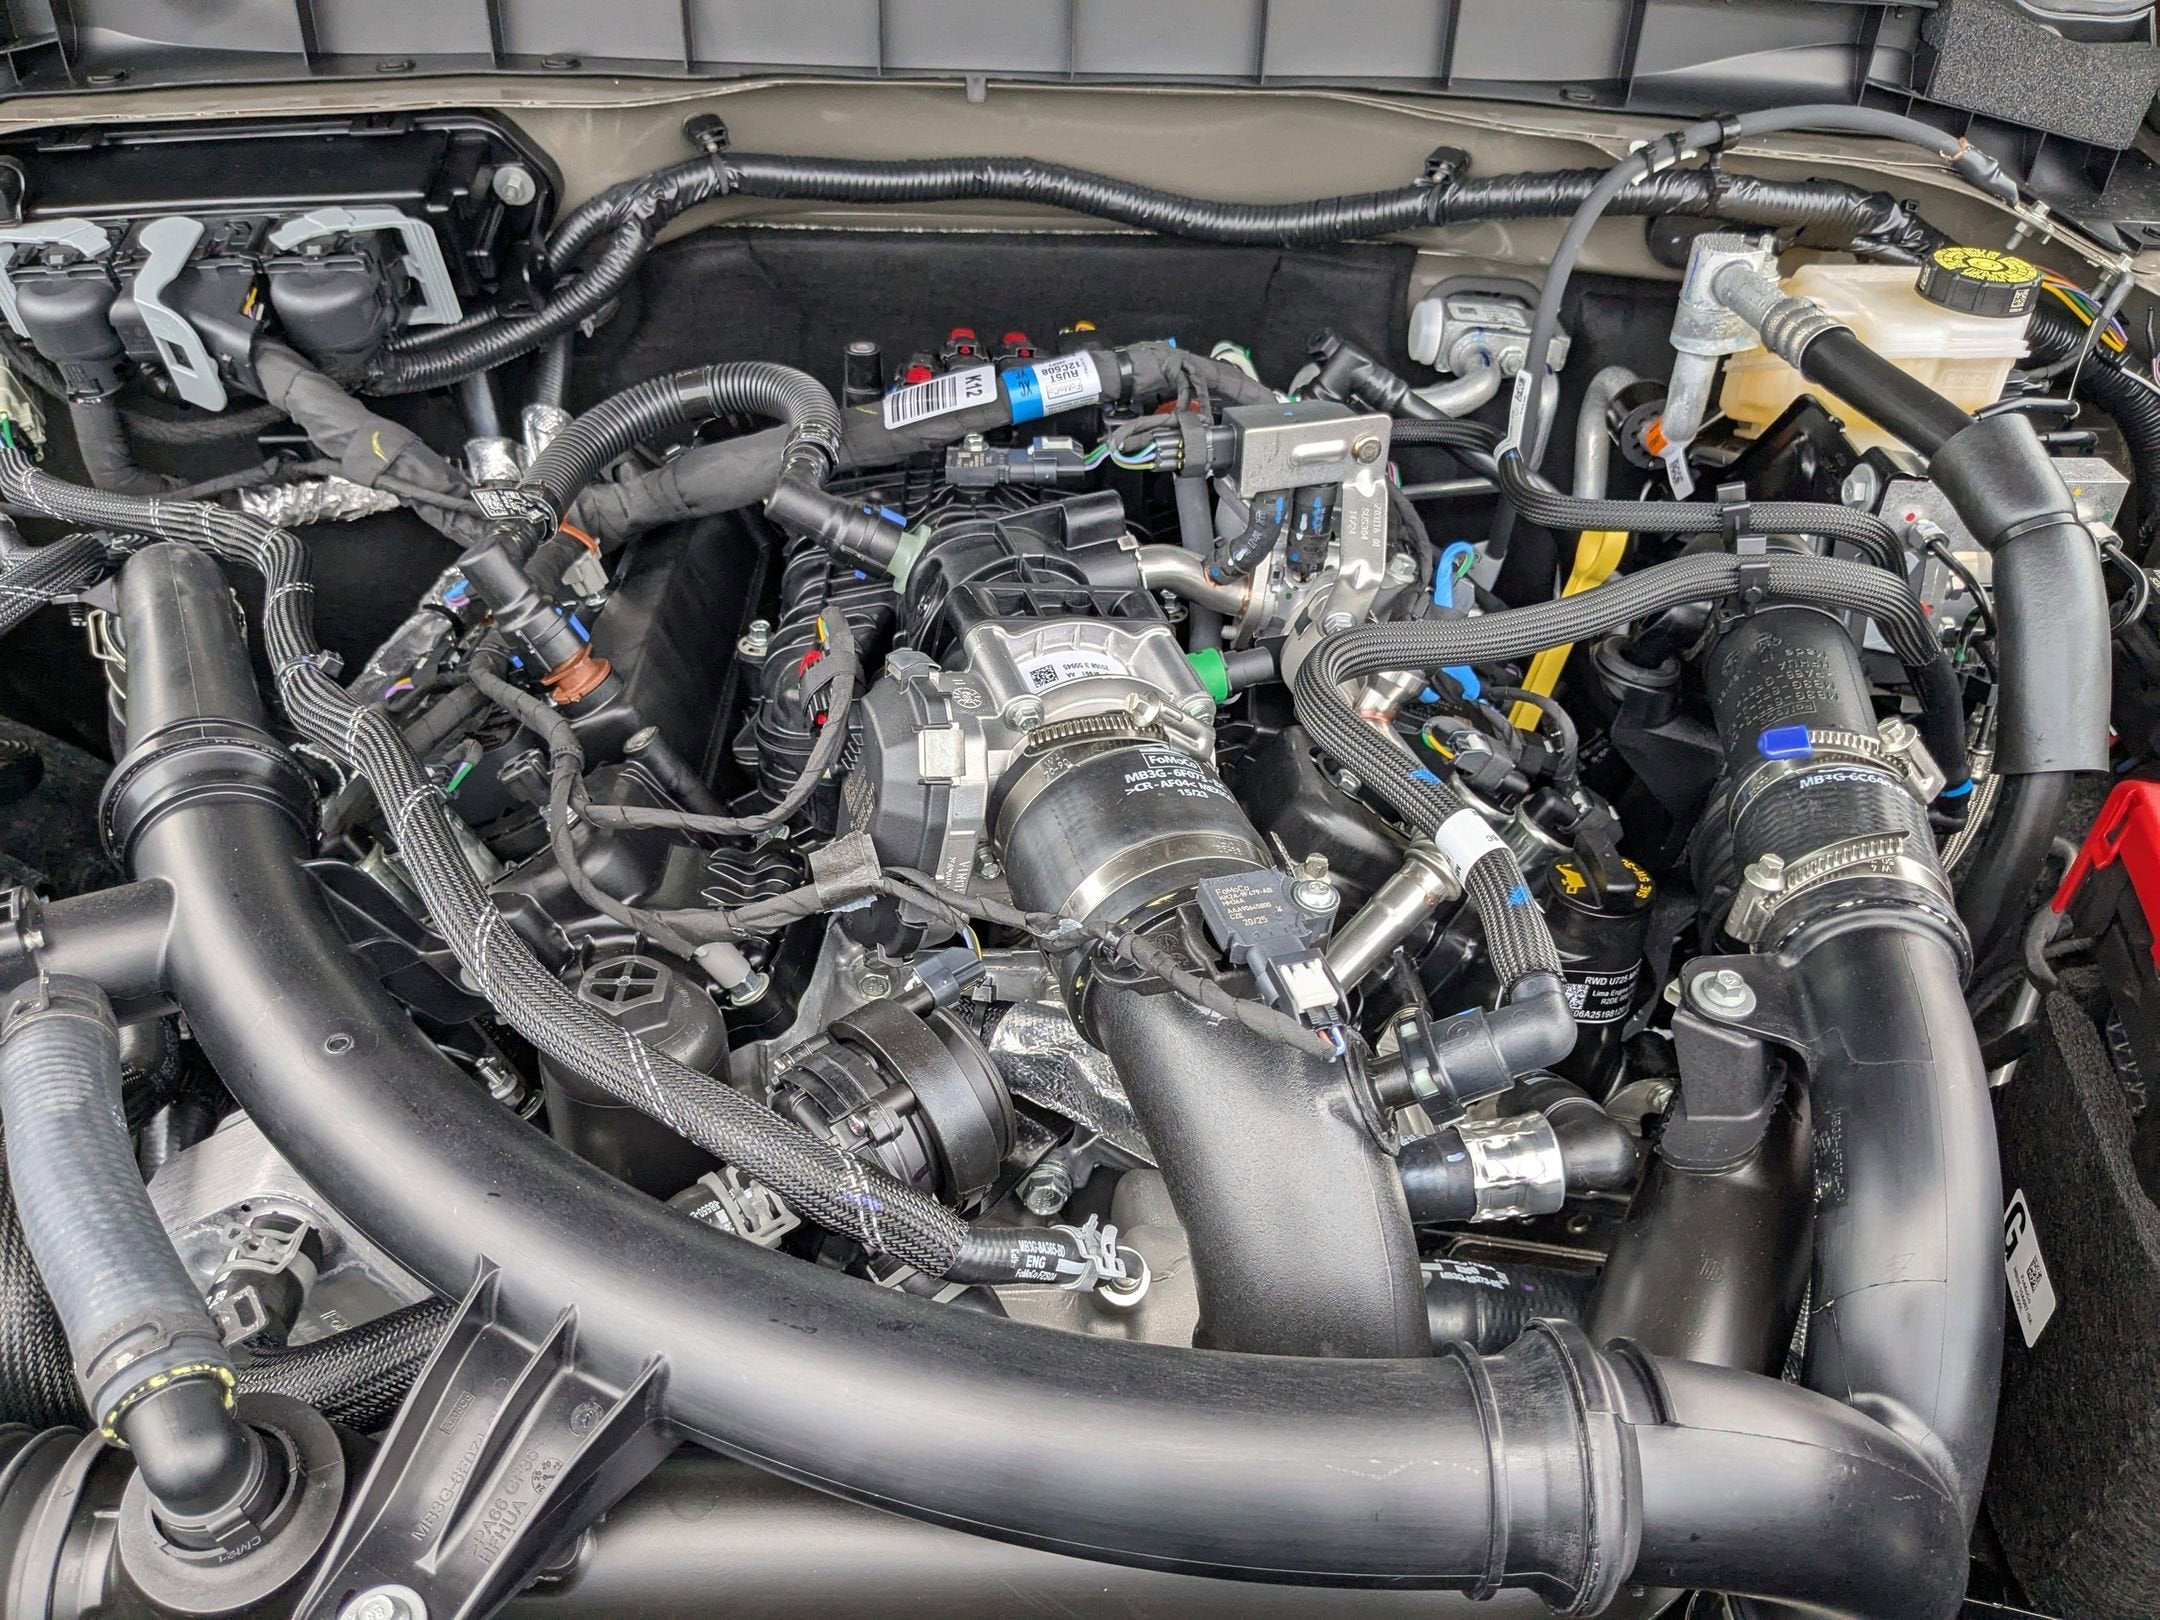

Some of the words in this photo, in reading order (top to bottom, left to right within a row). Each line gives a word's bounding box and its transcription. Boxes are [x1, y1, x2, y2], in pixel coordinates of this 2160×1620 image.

[1042, 362, 1082, 376] 12C508
[965, 374, 983, 398] K12
[1019, 380, 1034, 397] XC
[1046, 381, 1083, 396] FoMoCo
[1360, 507, 1370, 540] SUS304
[1148, 755, 1198, 769] FoMoCo
[1215, 885, 1250, 896] FoMoCo
[1635, 886, 1652, 899] SAE
[1242, 915, 1268, 926] 20/25
[1584, 976, 1607, 986] RWD
[1609, 975, 1629, 986] U725
[1592, 989, 1609, 997] Lima
[2004, 1201, 2026, 1263] G
[1025, 1255, 1047, 1269] ENG
[478, 1500, 527, 1564] HFHUA
